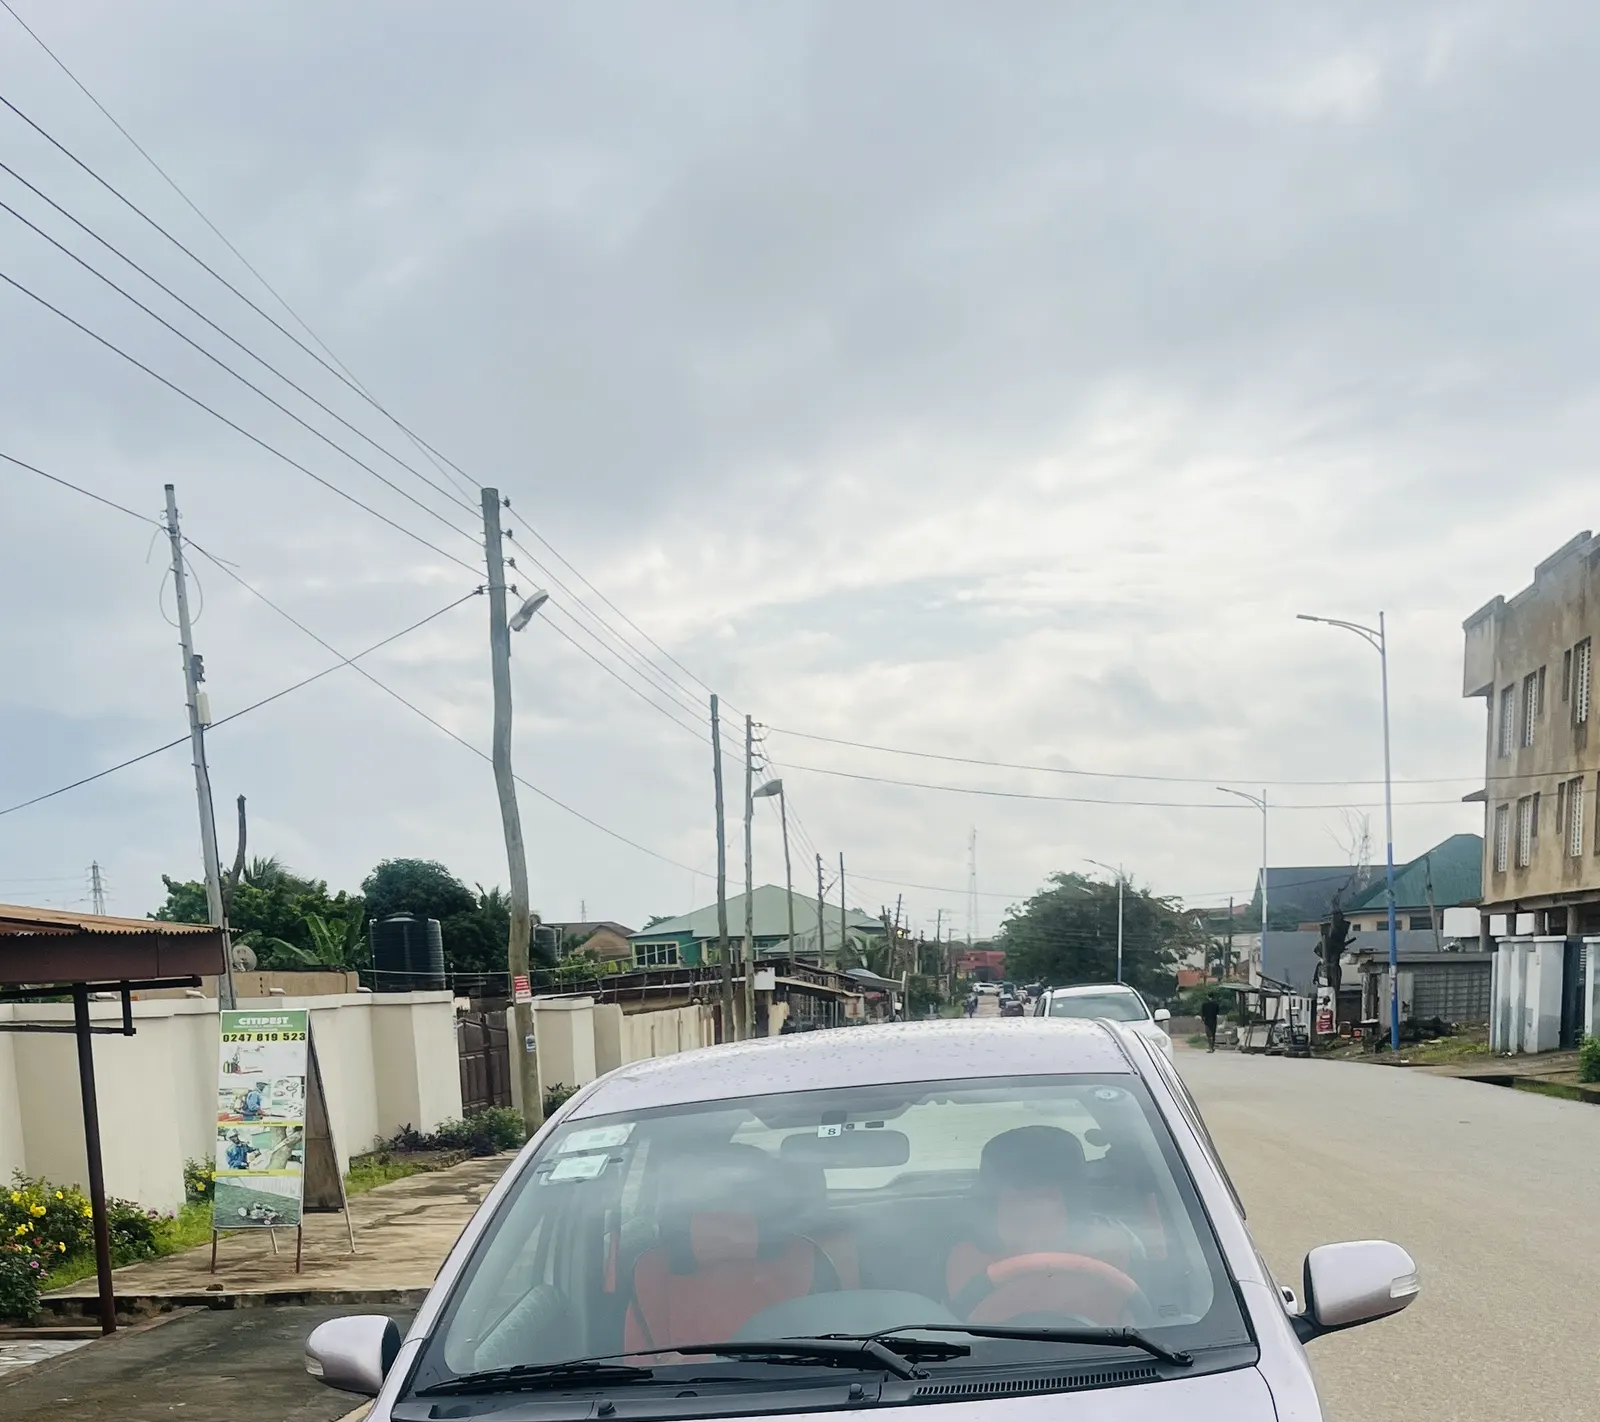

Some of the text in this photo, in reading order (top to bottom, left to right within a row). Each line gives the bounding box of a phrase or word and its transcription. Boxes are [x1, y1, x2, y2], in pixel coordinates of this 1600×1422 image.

[223, 1032, 306, 1042] 0247 819 523
